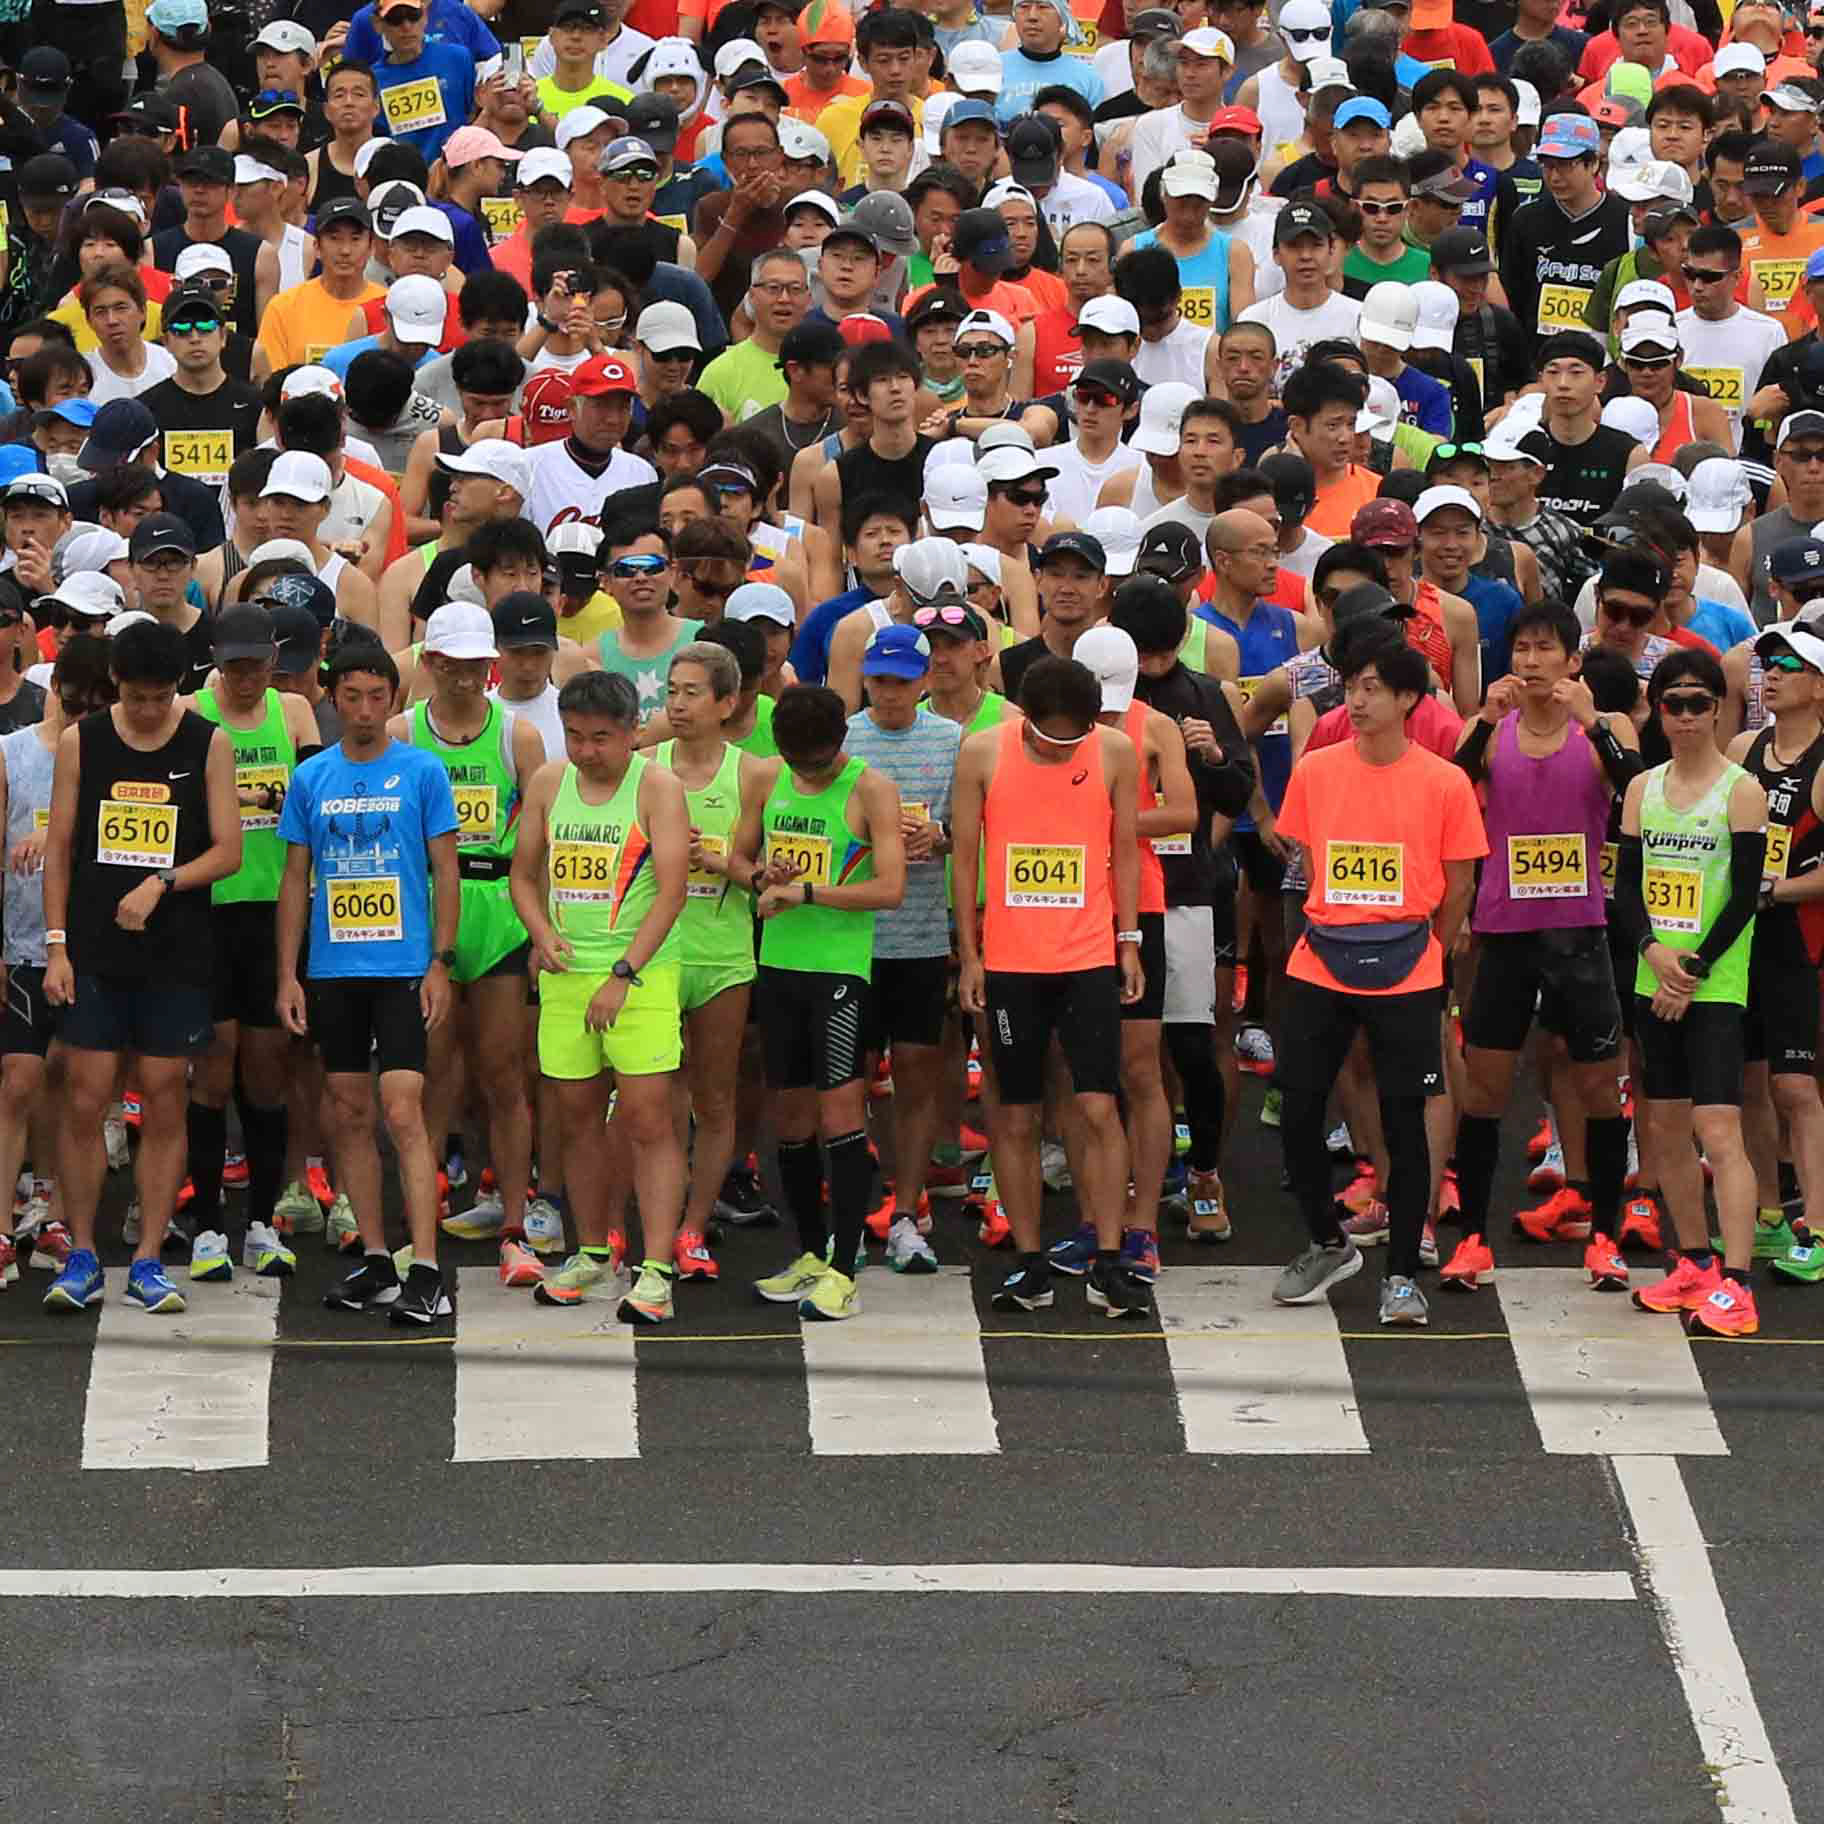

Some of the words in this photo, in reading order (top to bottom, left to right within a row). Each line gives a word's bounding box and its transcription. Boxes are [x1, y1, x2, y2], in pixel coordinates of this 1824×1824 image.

[387, 90, 437, 117] 6379
[171, 443, 228, 466] 5414
[104, 819, 170, 845] 6510
[1642, 829, 1718, 852] Runpro
[554, 856, 608, 879] 6138
[1014, 858, 1082, 886] 6041
[1332, 856, 1397, 883] 6416
[1515, 847, 1582, 876] 5494
[332, 893, 396, 918] 6060
[1646, 881, 1696, 910] 5311
